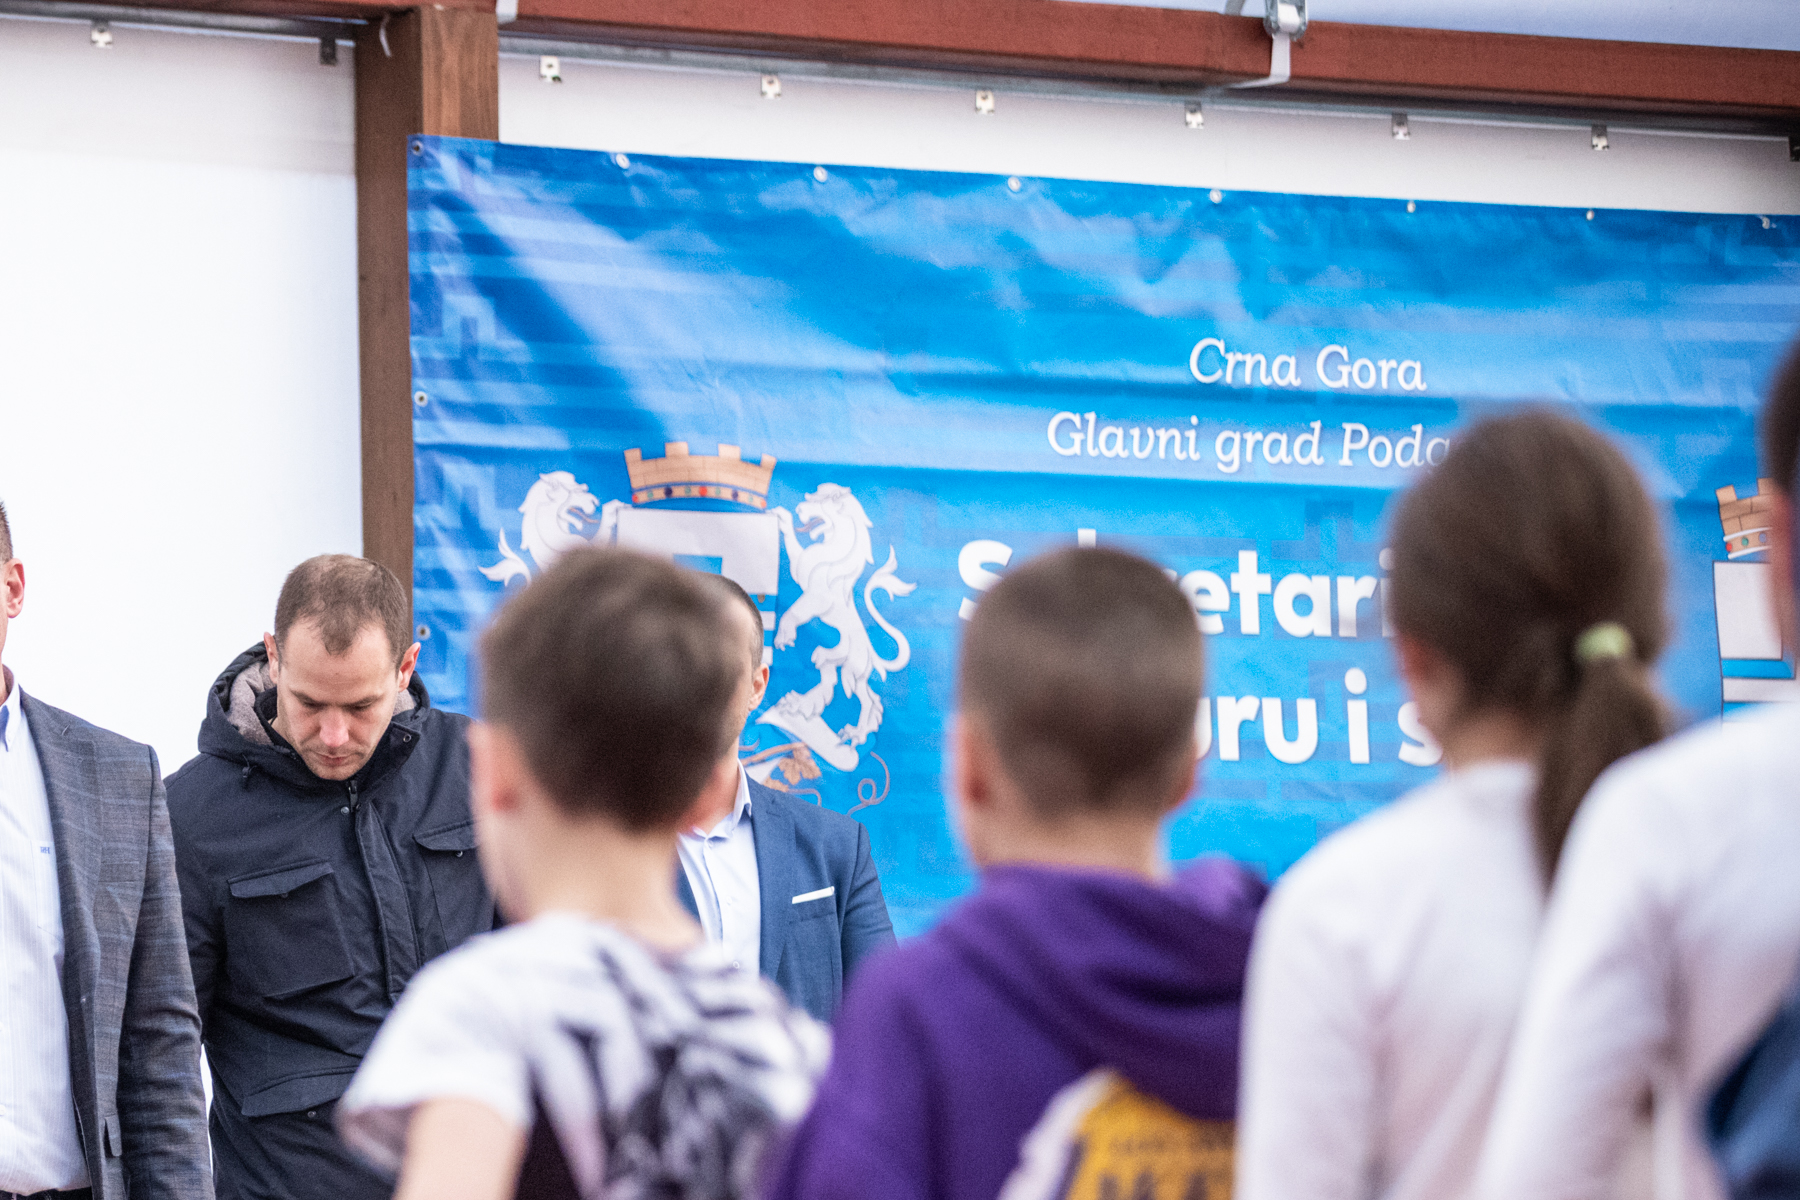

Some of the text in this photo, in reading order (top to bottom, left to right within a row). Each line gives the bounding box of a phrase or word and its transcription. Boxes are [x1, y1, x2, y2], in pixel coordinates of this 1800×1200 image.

[1189, 337, 1427, 391] Crna Gora
[1047, 410, 1201, 460] Glavni
[1214, 420, 1324, 474] grad
[1344, 667, 1370, 765] i
